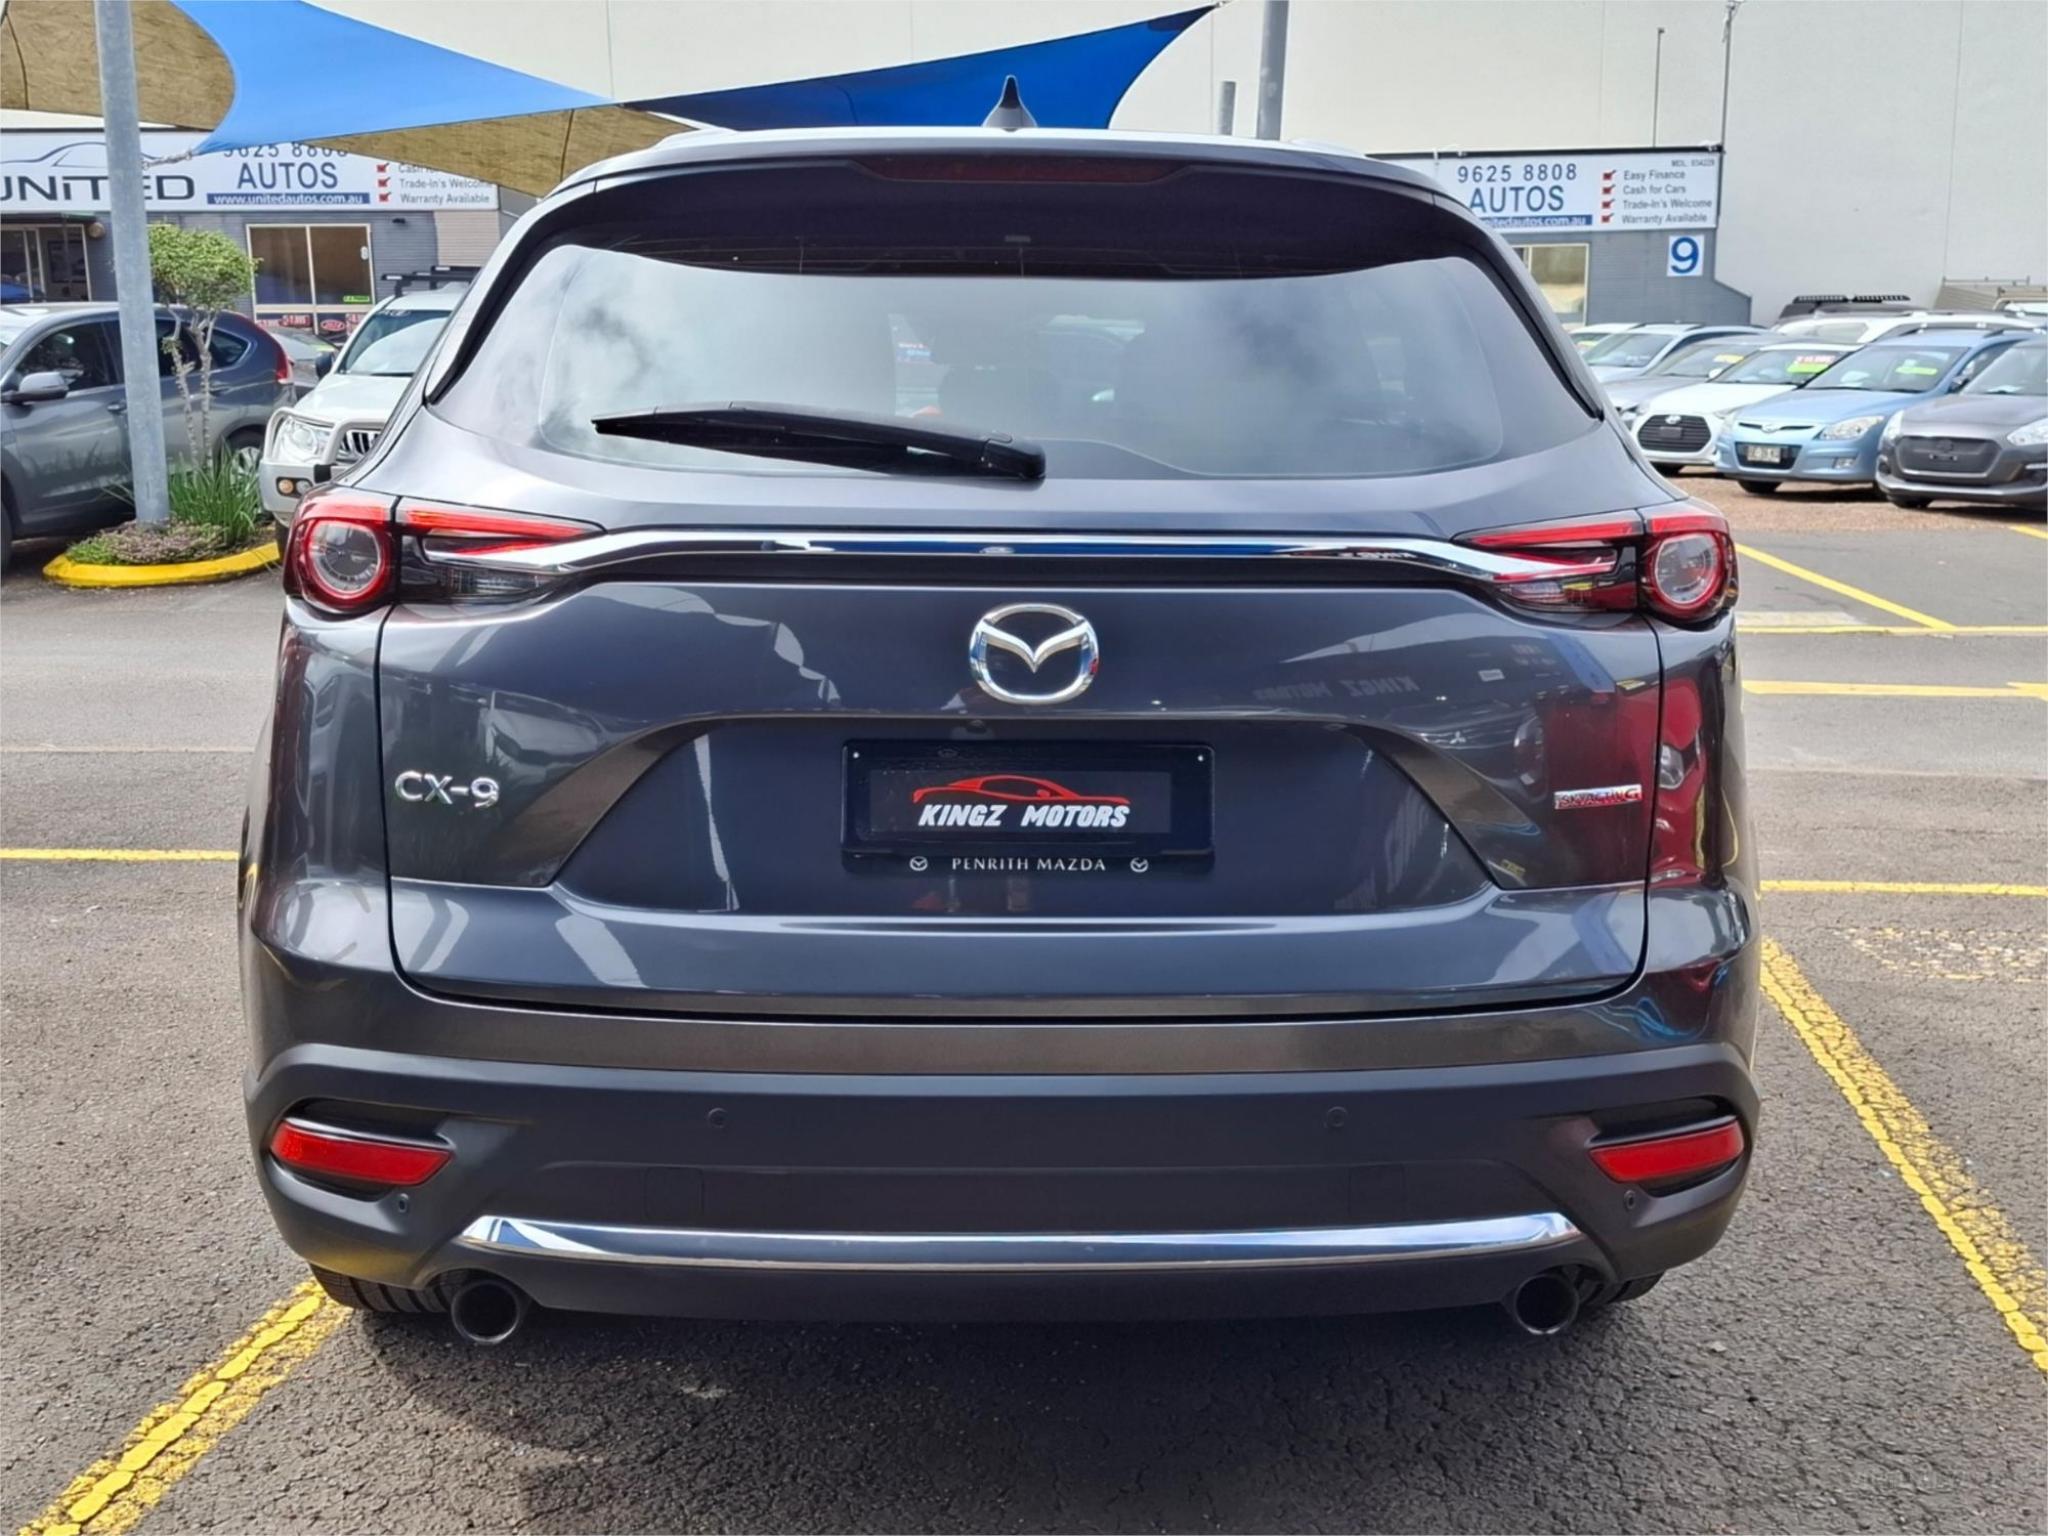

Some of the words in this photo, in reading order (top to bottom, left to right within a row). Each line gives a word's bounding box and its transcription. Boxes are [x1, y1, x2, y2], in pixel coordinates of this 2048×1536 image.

[236, 162, 338, 190] AUTOS
[1457, 165, 1512, 183] 9625
[1523, 163, 1577, 181] 8808
[1623, 170, 1645, 181] Easy
[1648, 169, 1685, 179] Finance
[1623, 186, 1646, 195] Cash
[1649, 185, 1662, 194] for
[1665, 184, 1686, 194] Cars
[214, 193, 363, 205] www.unitedautos.com.au
[1469, 185, 1564, 213] AUTOS
[1670, 198, 1712, 208] Welcome
[1622, 215, 1662, 225] Warranty
[1665, 214, 1707, 223] Available
[1670, 236, 1699, 274] 9
[395, 770, 500, 807] CX-9
[918, 804, 1007, 827] KINGZ
[1021, 805, 1131, 828] MOTORS
[952, 857, 1029, 871] PENRITH
[1036, 857, 1107, 872] MAZDA
